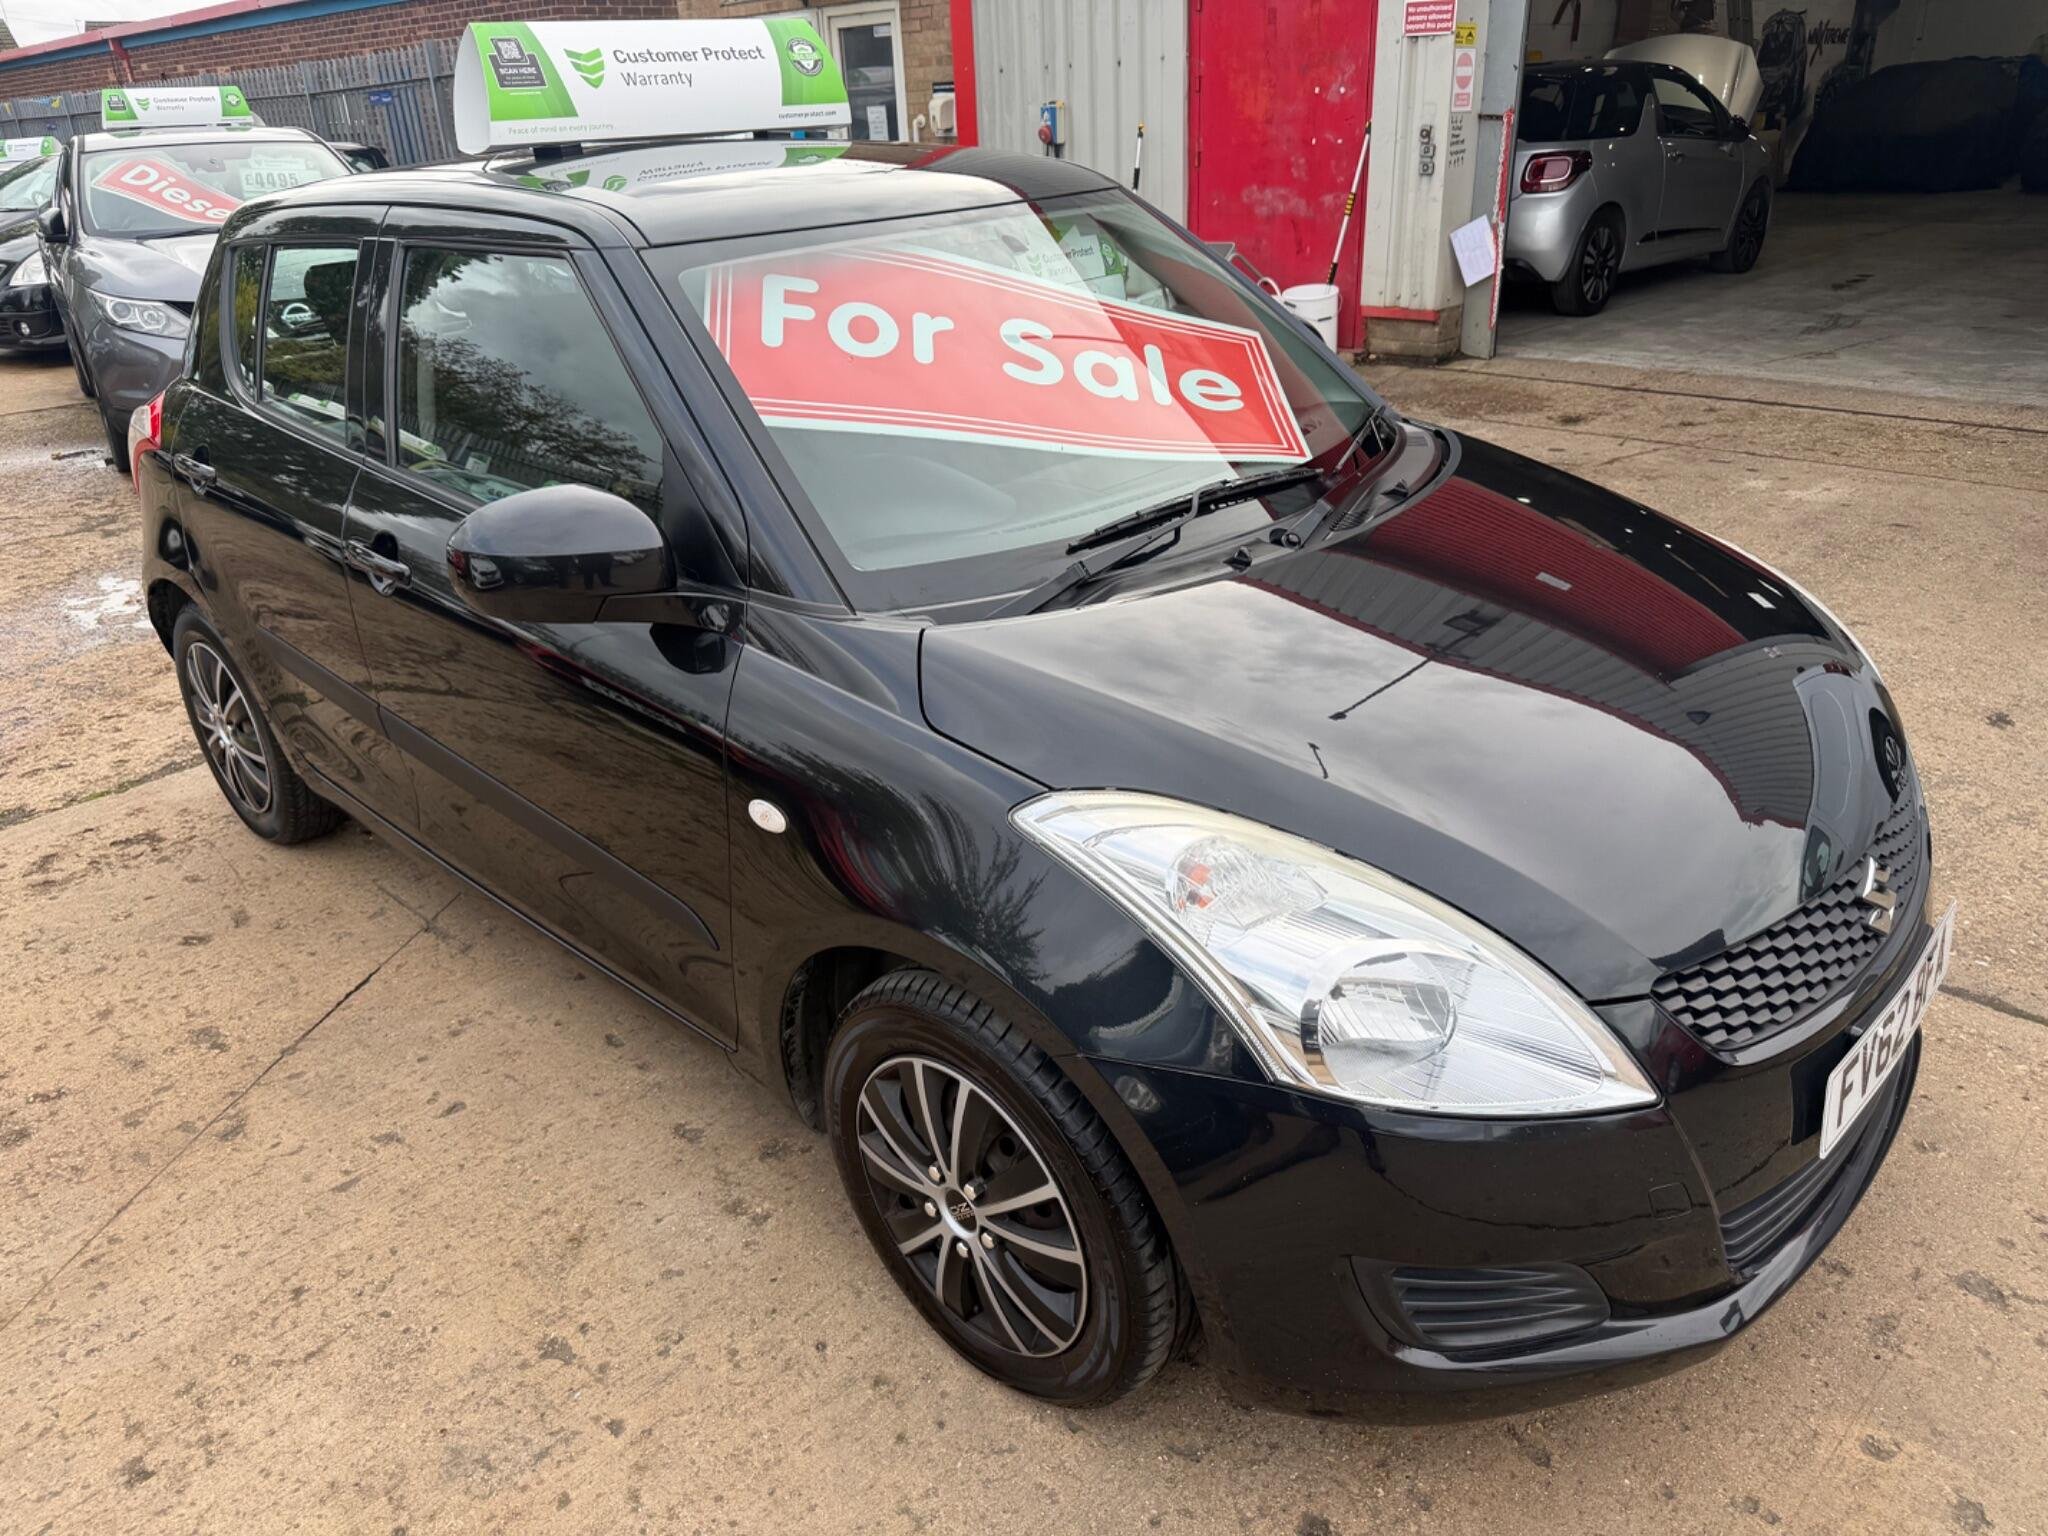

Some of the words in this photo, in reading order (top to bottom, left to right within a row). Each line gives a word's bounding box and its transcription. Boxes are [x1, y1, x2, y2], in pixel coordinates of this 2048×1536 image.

[612, 48, 699, 64] Customer
[701, 45, 765, 62] Protect
[620, 71, 693, 88] Warranty
[761, 273, 954, 364] For
[1000, 318, 1246, 411] Sale
